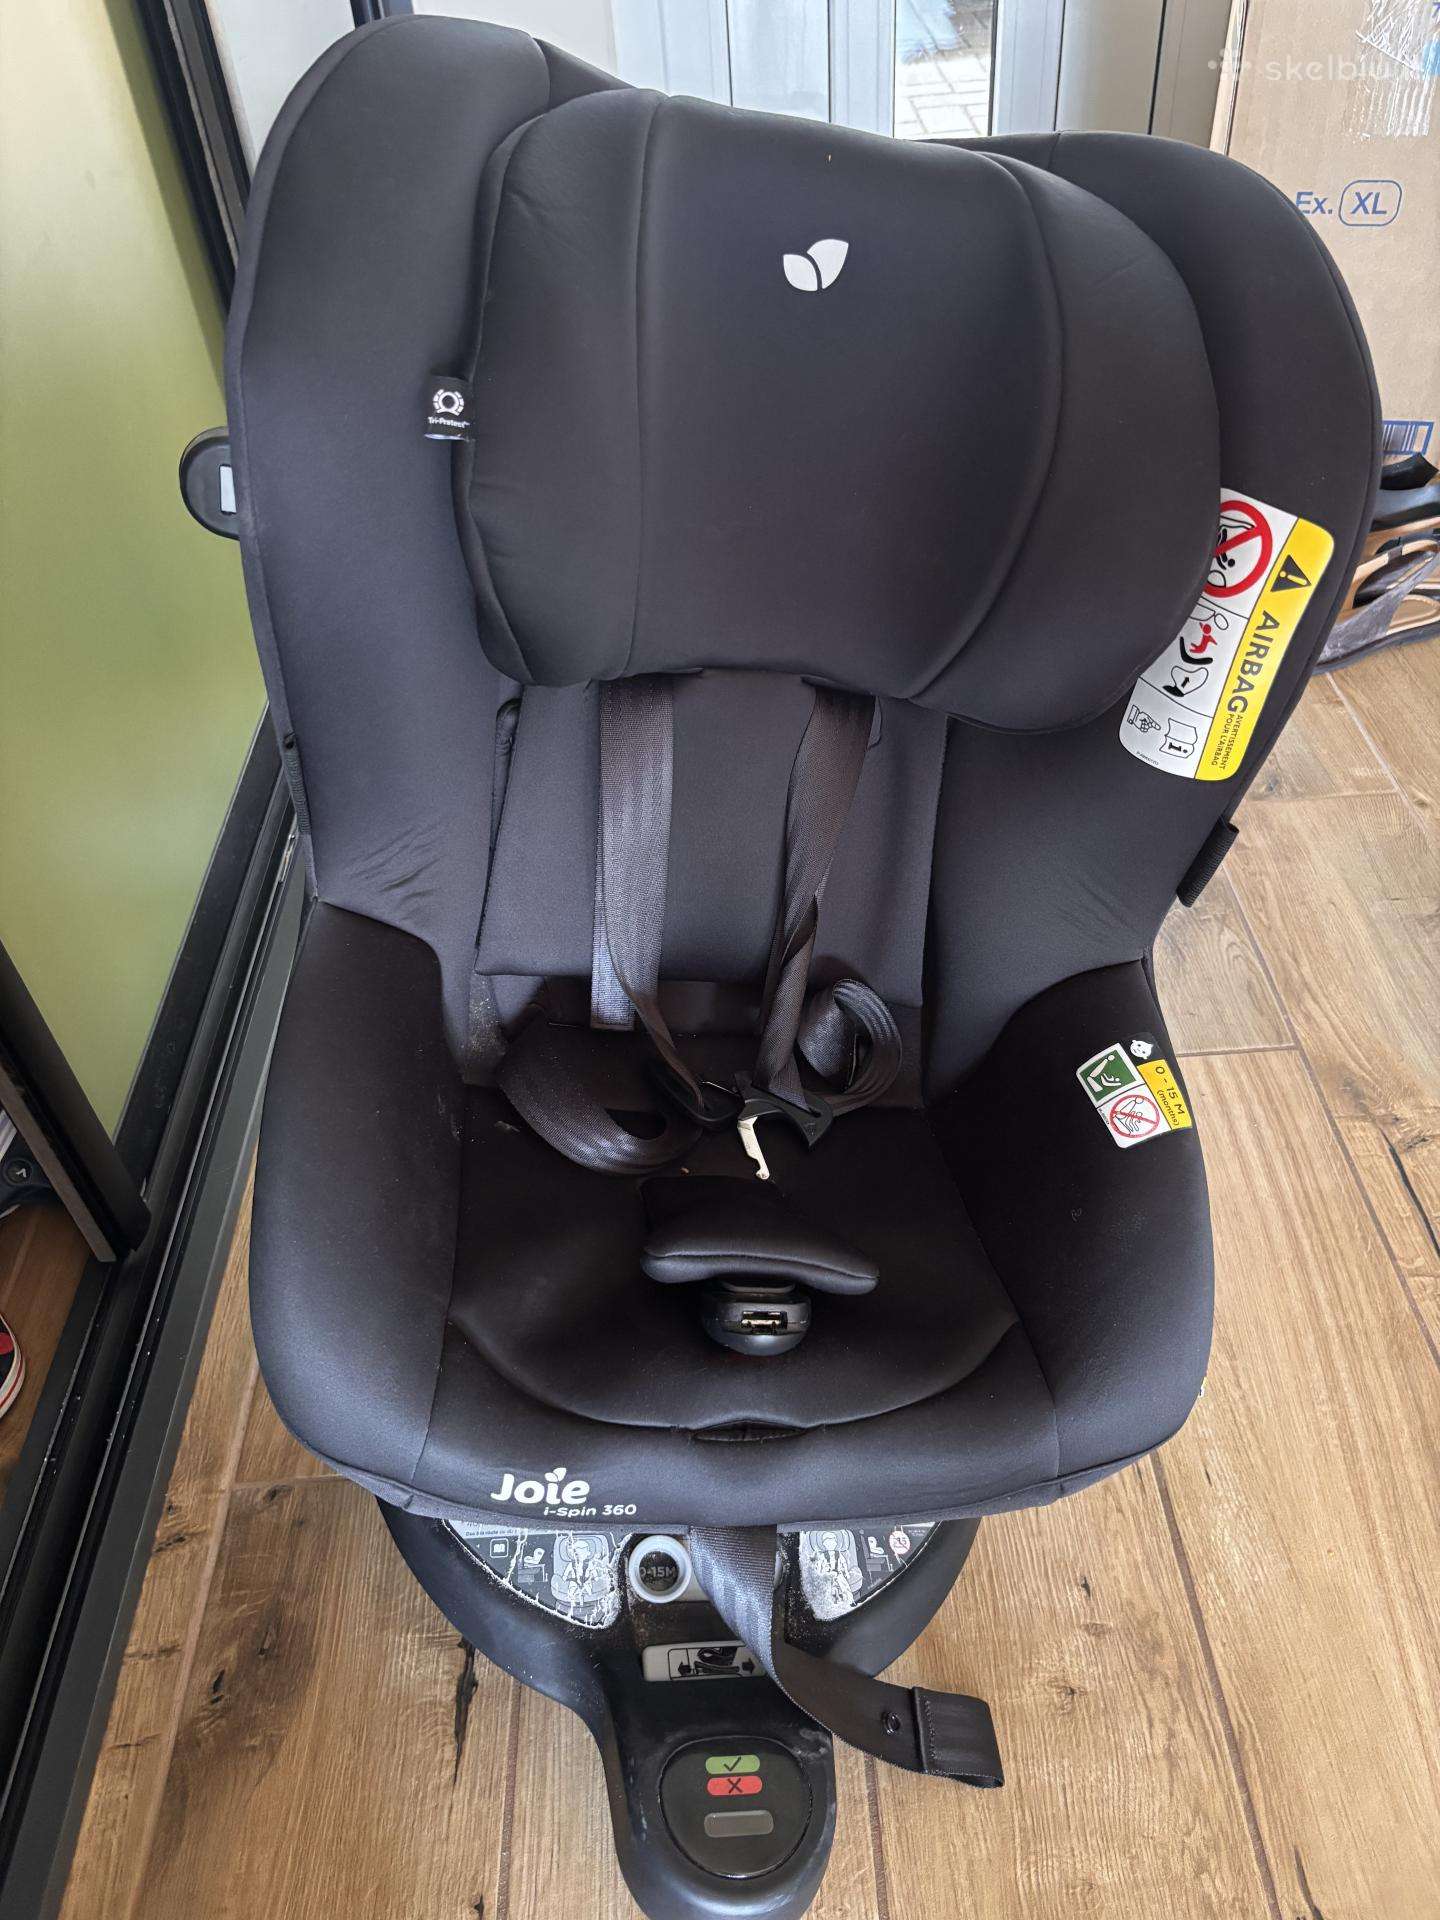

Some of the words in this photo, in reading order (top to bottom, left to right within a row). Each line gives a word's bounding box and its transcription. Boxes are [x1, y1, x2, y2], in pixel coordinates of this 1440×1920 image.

[1296, 191, 1333, 215] Ex.
[1351, 191, 1388, 215] XL
[1227, 610, 1280, 714] AIRBAG
[1219, 714, 1244, 770] AVERTISSEMENT
[1156, 1089, 1180, 1126] (months)
[490, 1467, 590, 1505] Joie
[543, 1506, 597, 1518] i-Spin
[601, 1504, 637, 1516] 360
